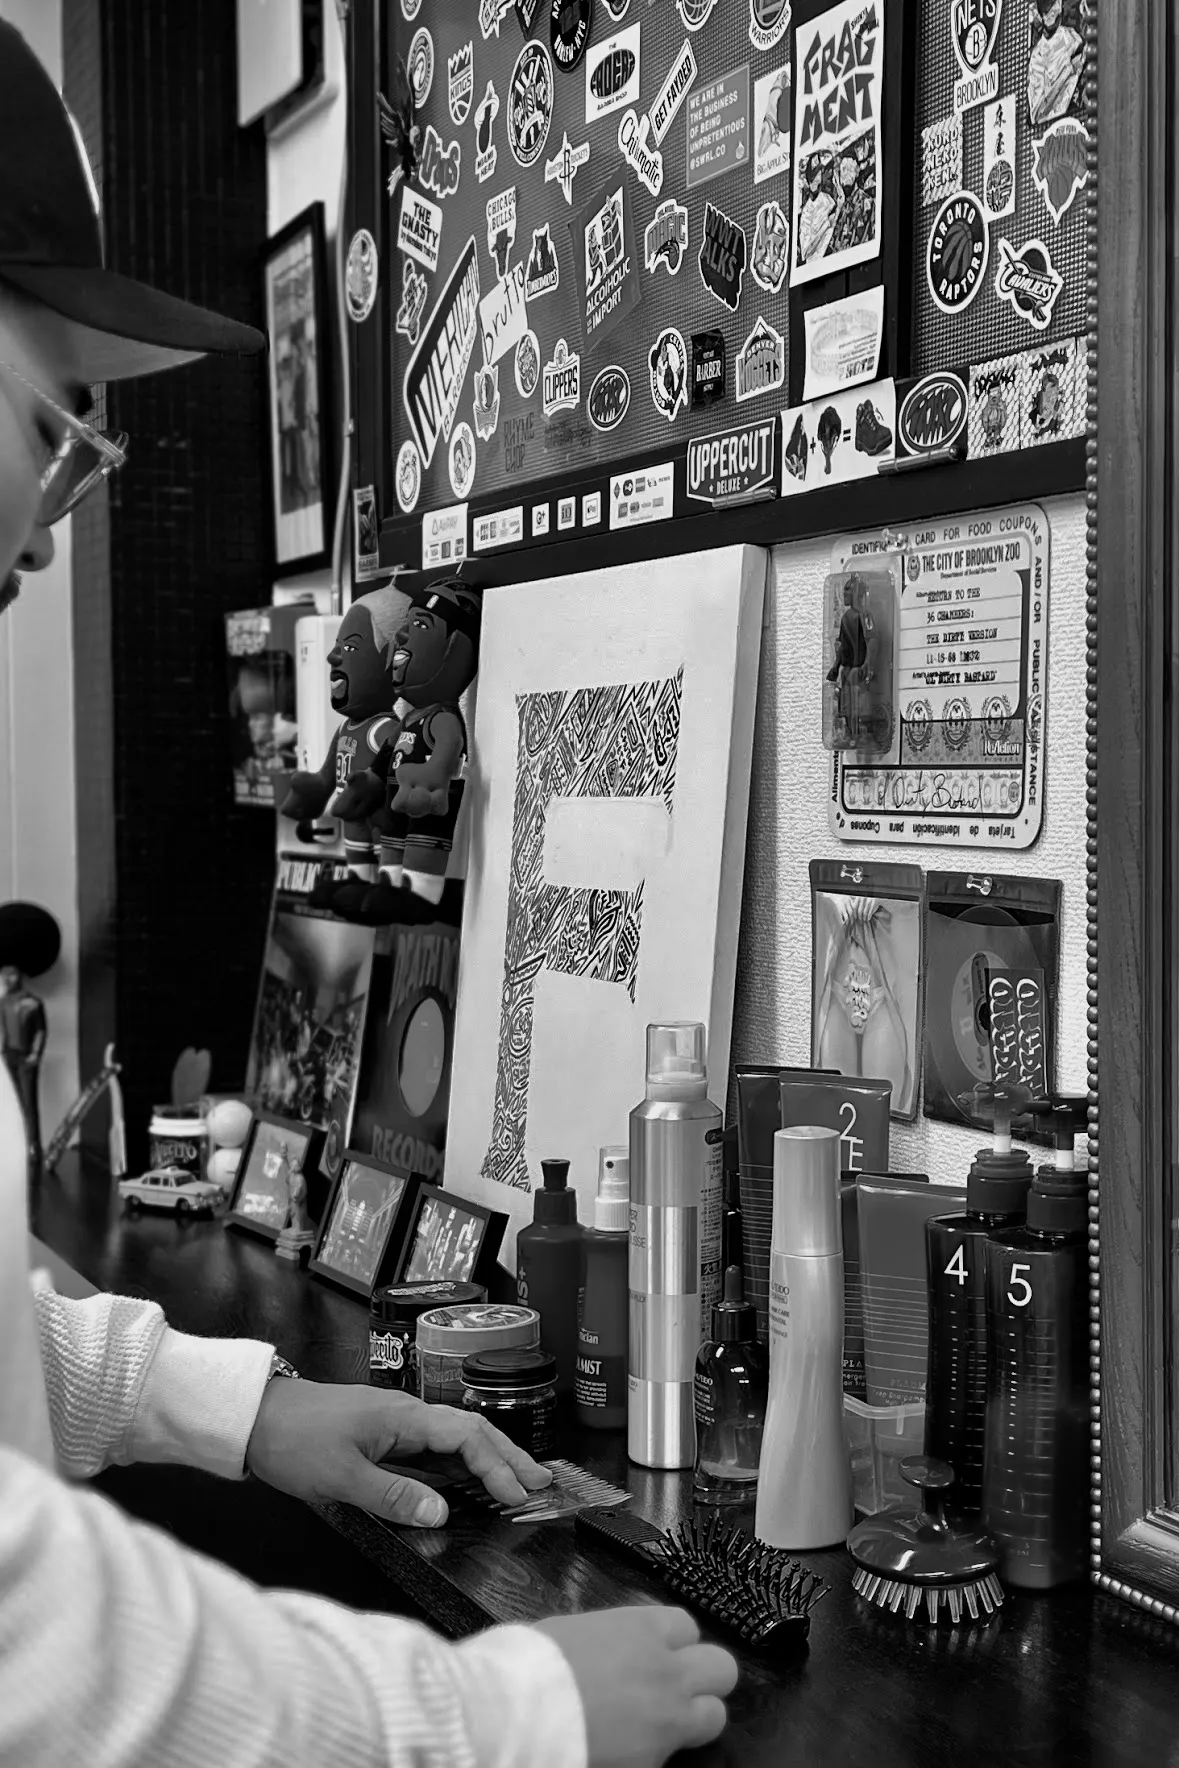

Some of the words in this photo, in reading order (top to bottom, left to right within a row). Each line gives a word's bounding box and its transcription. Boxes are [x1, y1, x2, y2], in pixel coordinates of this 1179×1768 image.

[751, 10, 790, 44] WARRIORS
[803, 20, 877, 95] FRAG
[655, 100, 668, 131] GET
[666, 55, 693, 104] FAYDED
[690, 96, 700, 109] WE
[701, 87, 715, 104] ARE
[716, 83, 724, 96] IN
[957, 70, 996, 109] BROOKLYN
[690, 108, 703, 124] THE
[704, 90, 738, 117] BUSINESS
[800, 73, 875, 147] MENT
[690, 127, 699, 139] OF
[700, 114, 721, 134] BEING
[690, 117, 745, 153] UNPRETENTIOUS
[767, 156, 782, 170] APPLE
[414, 201, 432, 226] THE
[487, 190, 516, 217] CHICAGO
[933, 203, 976, 263] TORONTO
[939, 242, 983, 300] RAPTORS
[748, 341, 776, 358] DENVER
[545, 365, 578, 405] CLIPPERS
[696, 360, 722, 382] BARBER
[690, 427, 771, 491] UPPERCUT
[716, 477, 741, 495] DELUXE
[915, 532, 936, 546] CARD
[943, 528, 960, 540] FOR
[968, 522, 992, 536] FOOD
[999, 516, 1042, 547] COUPONS
[922, 556, 934, 572] THE
[936, 553, 953, 570] CITY
[954, 551, 964, 568] OF
[965, 545, 1004, 567] BROOKLYN
[1005, 541, 1021, 561] ZOO
[955, 589, 965, 600] TO
[967, 587, 981, 598] THE
[926, 634, 939, 645] THE
[968, 628, 998, 641] VERSION
[1031, 640, 1041, 693] PUBLIC
[850, 820, 880, 834] Cupones
[889, 822, 904, 833] para
[969, 825, 979, 835] de
[988, 826, 1015, 839] Tarjeta
[839, 1102, 858, 1141] 2
[943, 1244, 969, 1286] 4
[1007, 1263, 1033, 1307] 5
